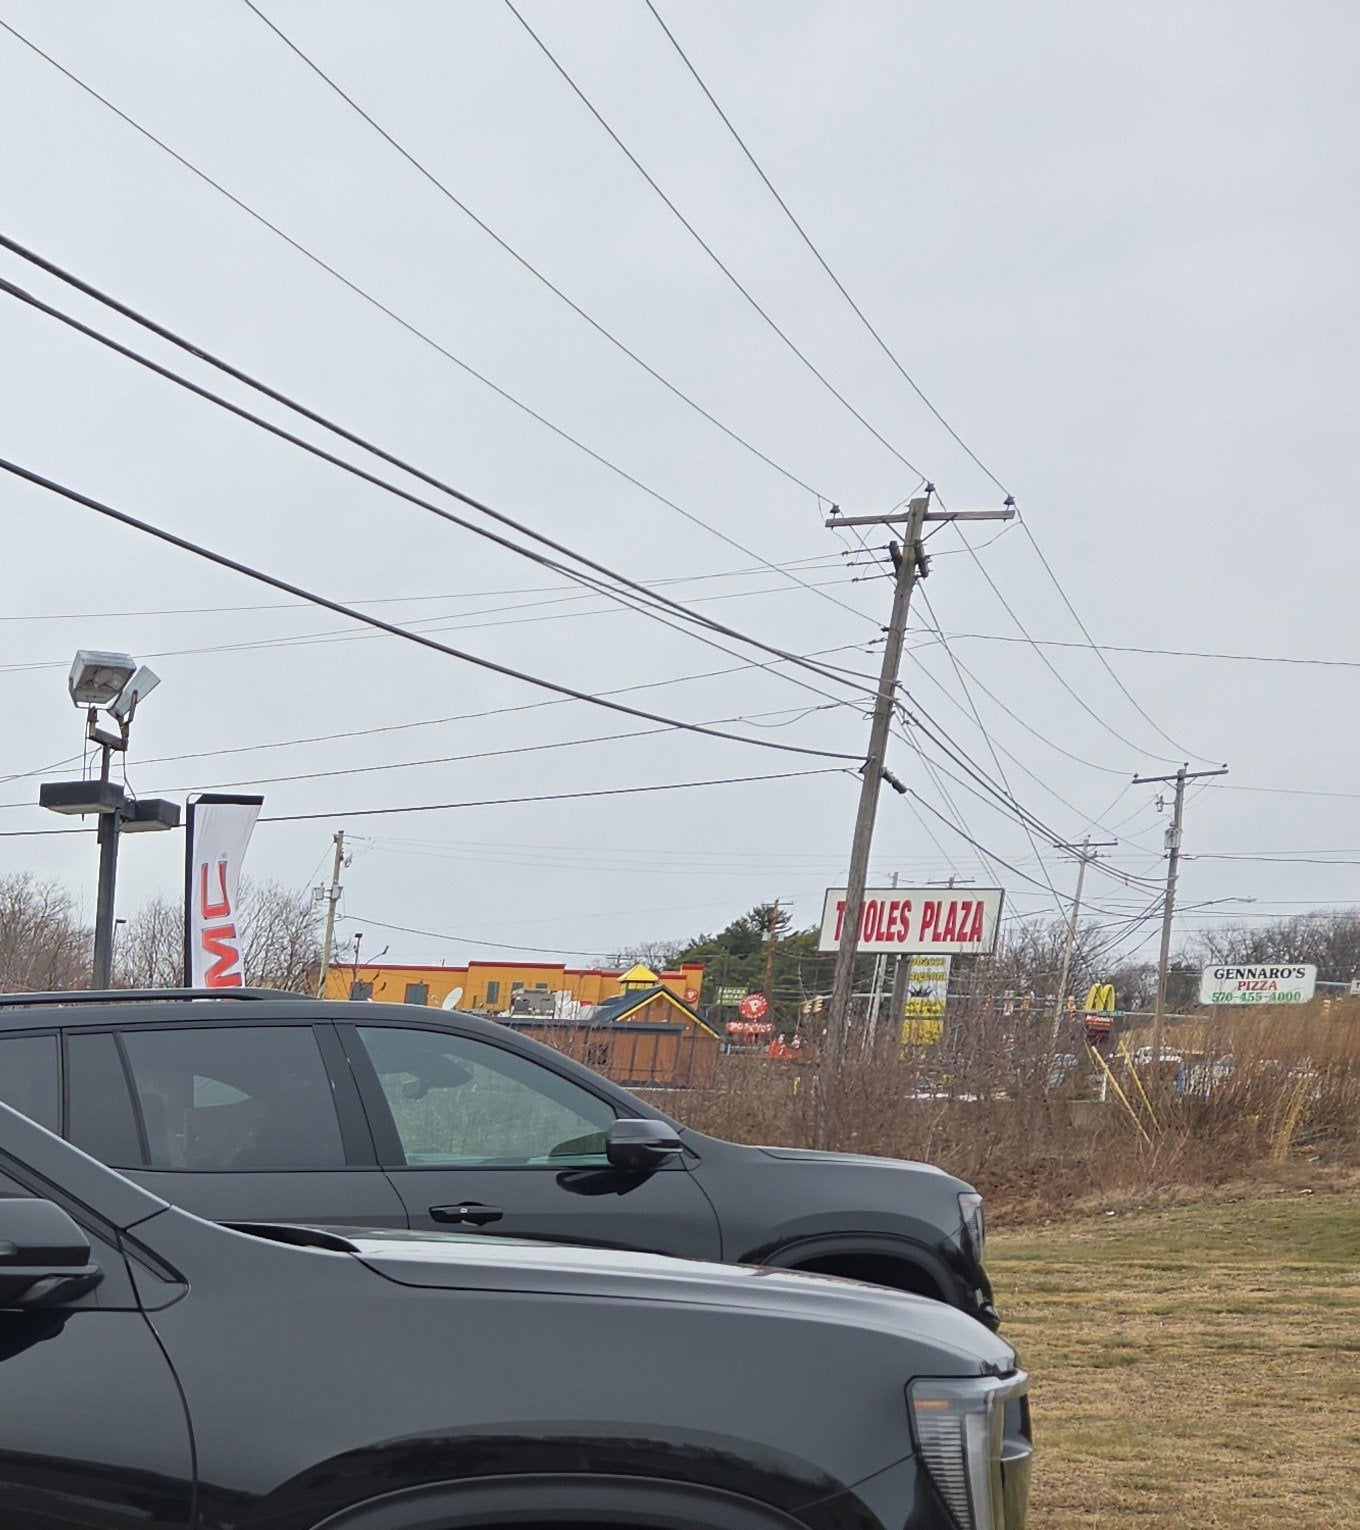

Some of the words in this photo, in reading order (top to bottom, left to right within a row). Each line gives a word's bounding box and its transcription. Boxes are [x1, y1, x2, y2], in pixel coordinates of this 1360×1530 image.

[918, 900, 985, 943] PLAZA
[1213, 967, 1306, 980] GENNARO'S
[1237, 980, 1278, 991] PIZZA
[1211, 991, 1302, 1003] 570-455-4000
